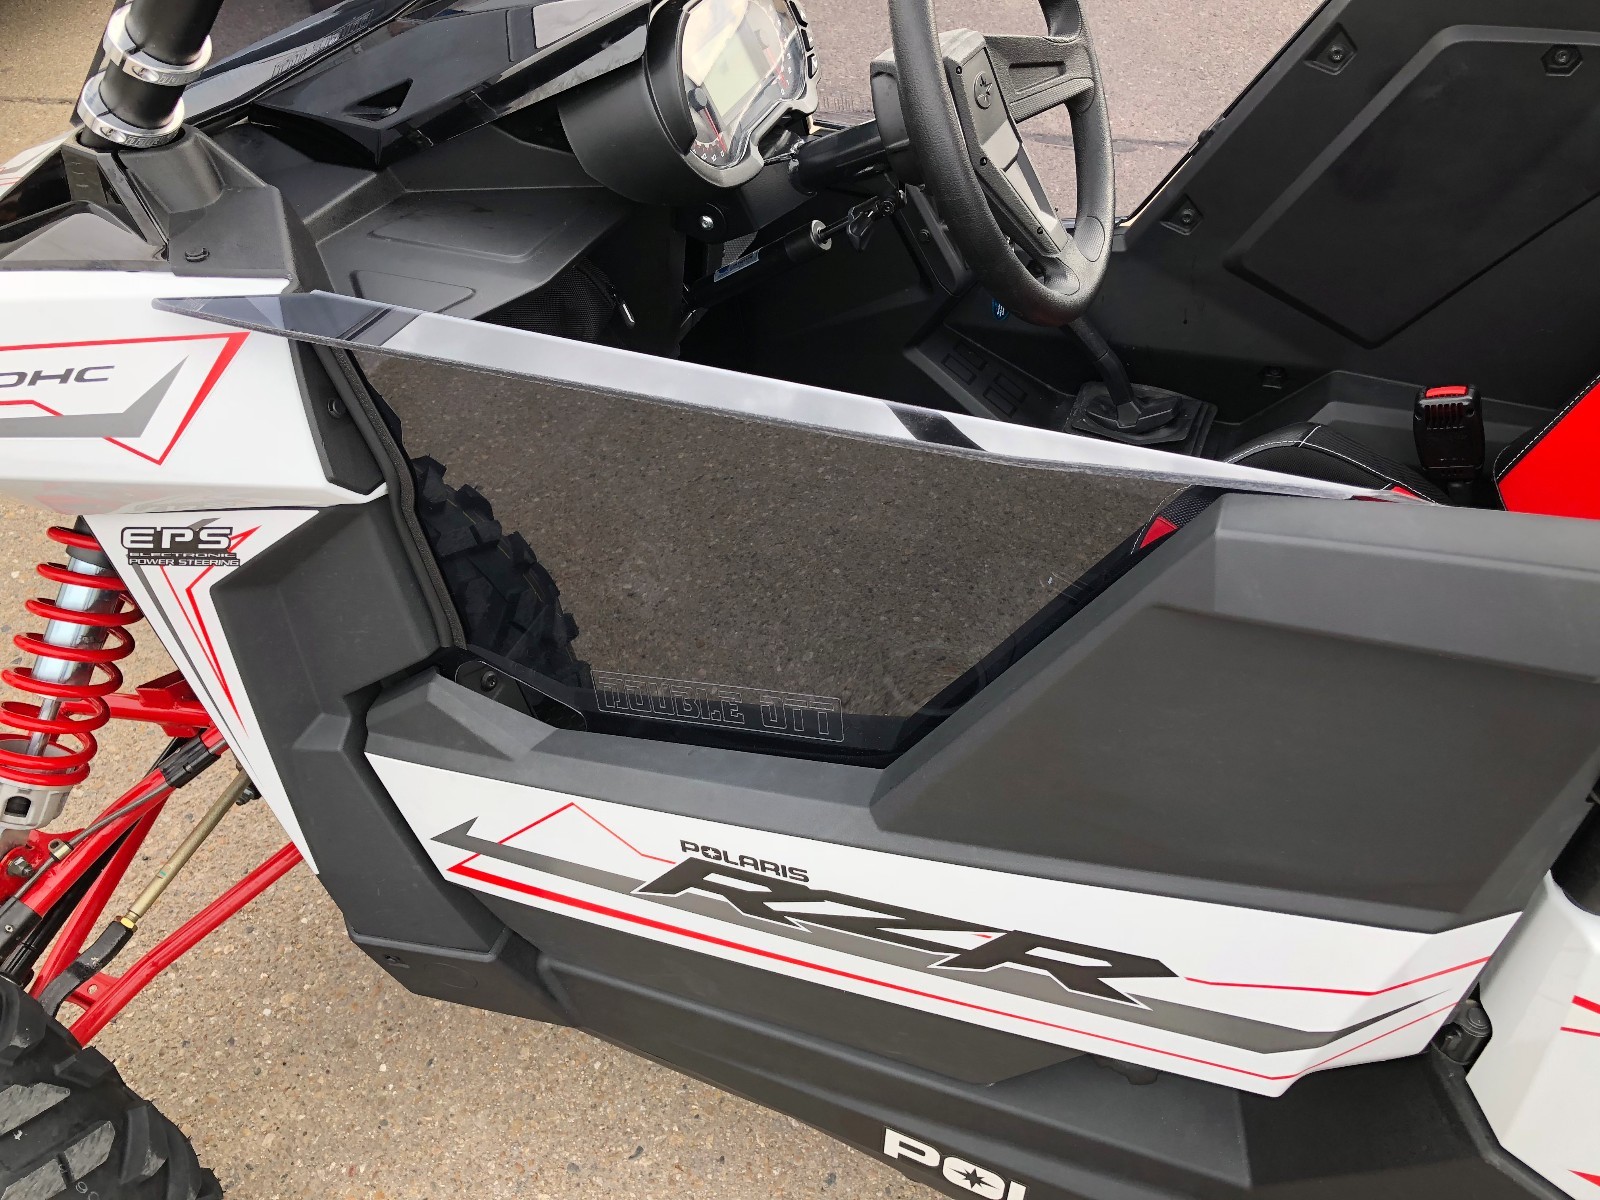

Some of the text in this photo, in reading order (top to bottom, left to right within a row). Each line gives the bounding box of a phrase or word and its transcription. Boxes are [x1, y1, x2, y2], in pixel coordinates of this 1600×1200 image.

[121, 527, 233, 549] EPS
[128, 558, 240, 566] POWER STEERING
[679, 839, 811, 882] POLARIS
[633, 857, 1179, 1009] RZR
